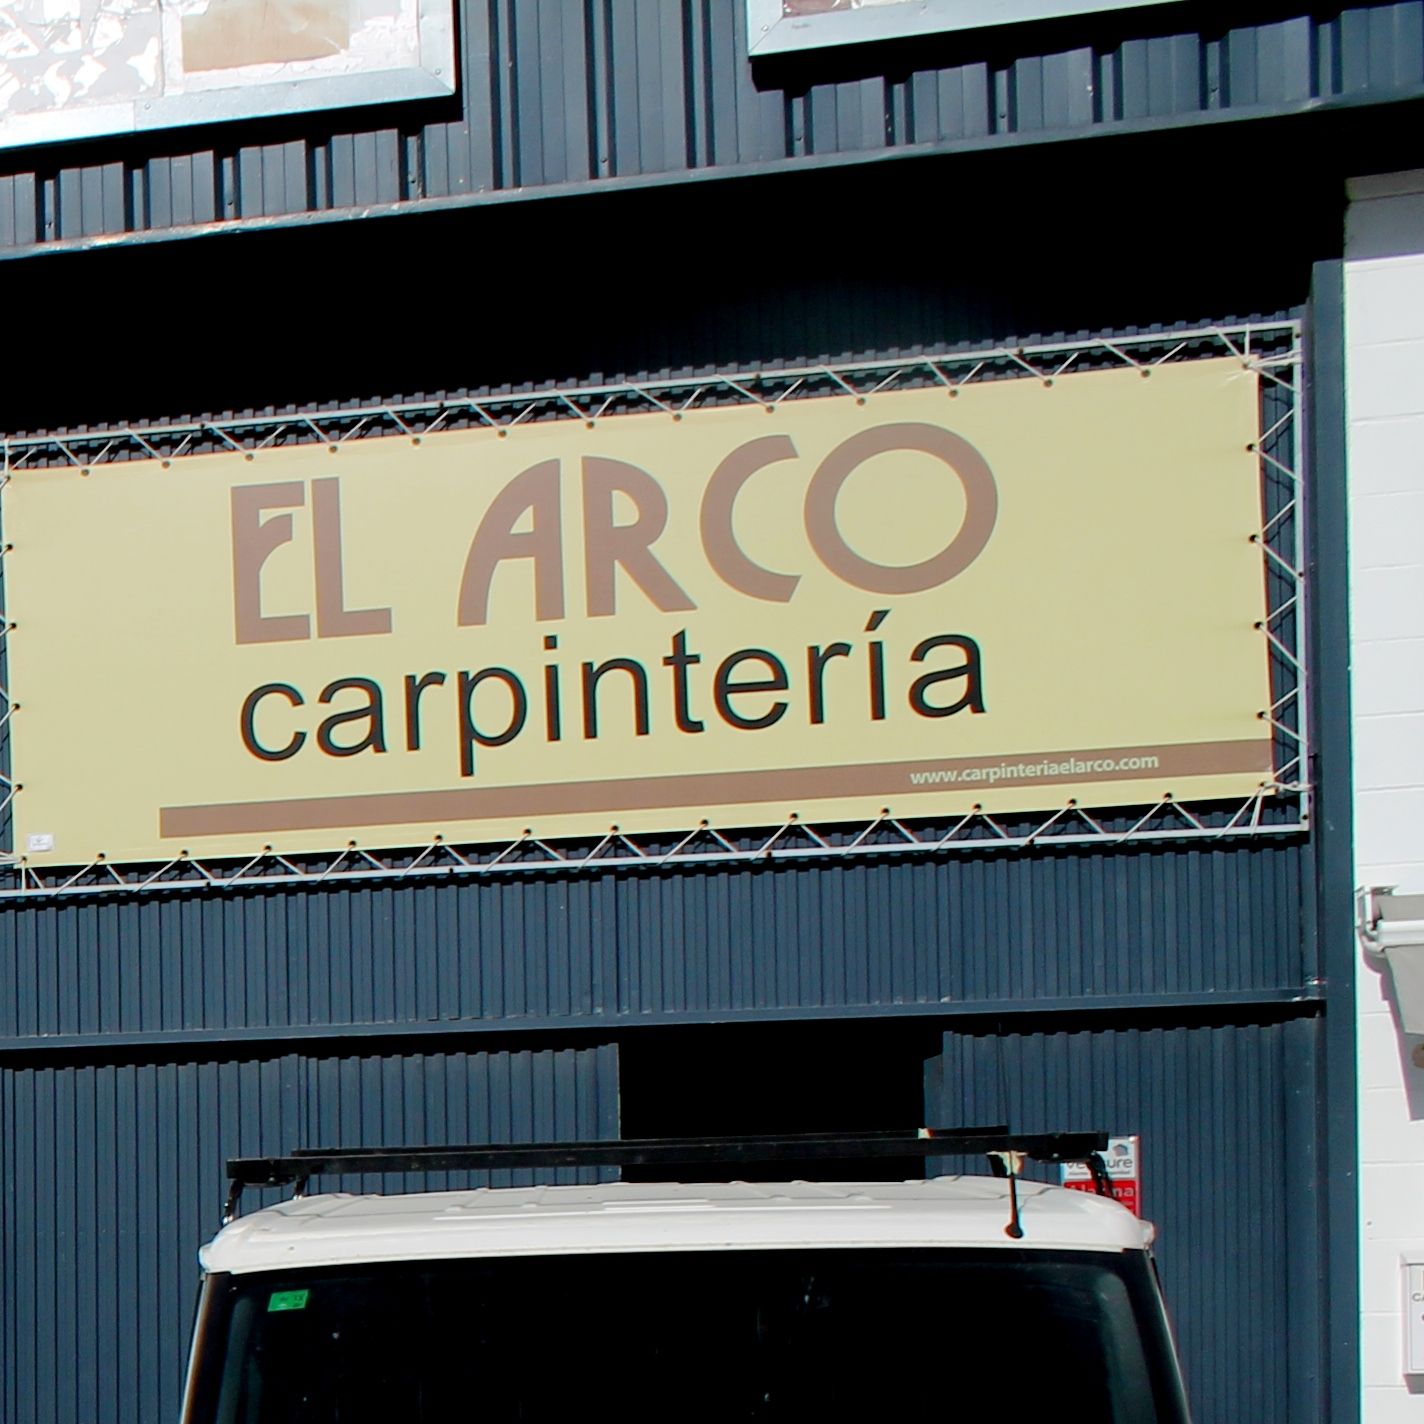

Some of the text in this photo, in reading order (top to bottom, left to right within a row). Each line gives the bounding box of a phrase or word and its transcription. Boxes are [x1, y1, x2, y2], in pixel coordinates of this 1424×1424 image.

[229, 421, 999, 646] EL ARCO
[239, 608, 987, 778] carpintería
[909, 755, 1159, 785] www.carpinteriaelarco.com
